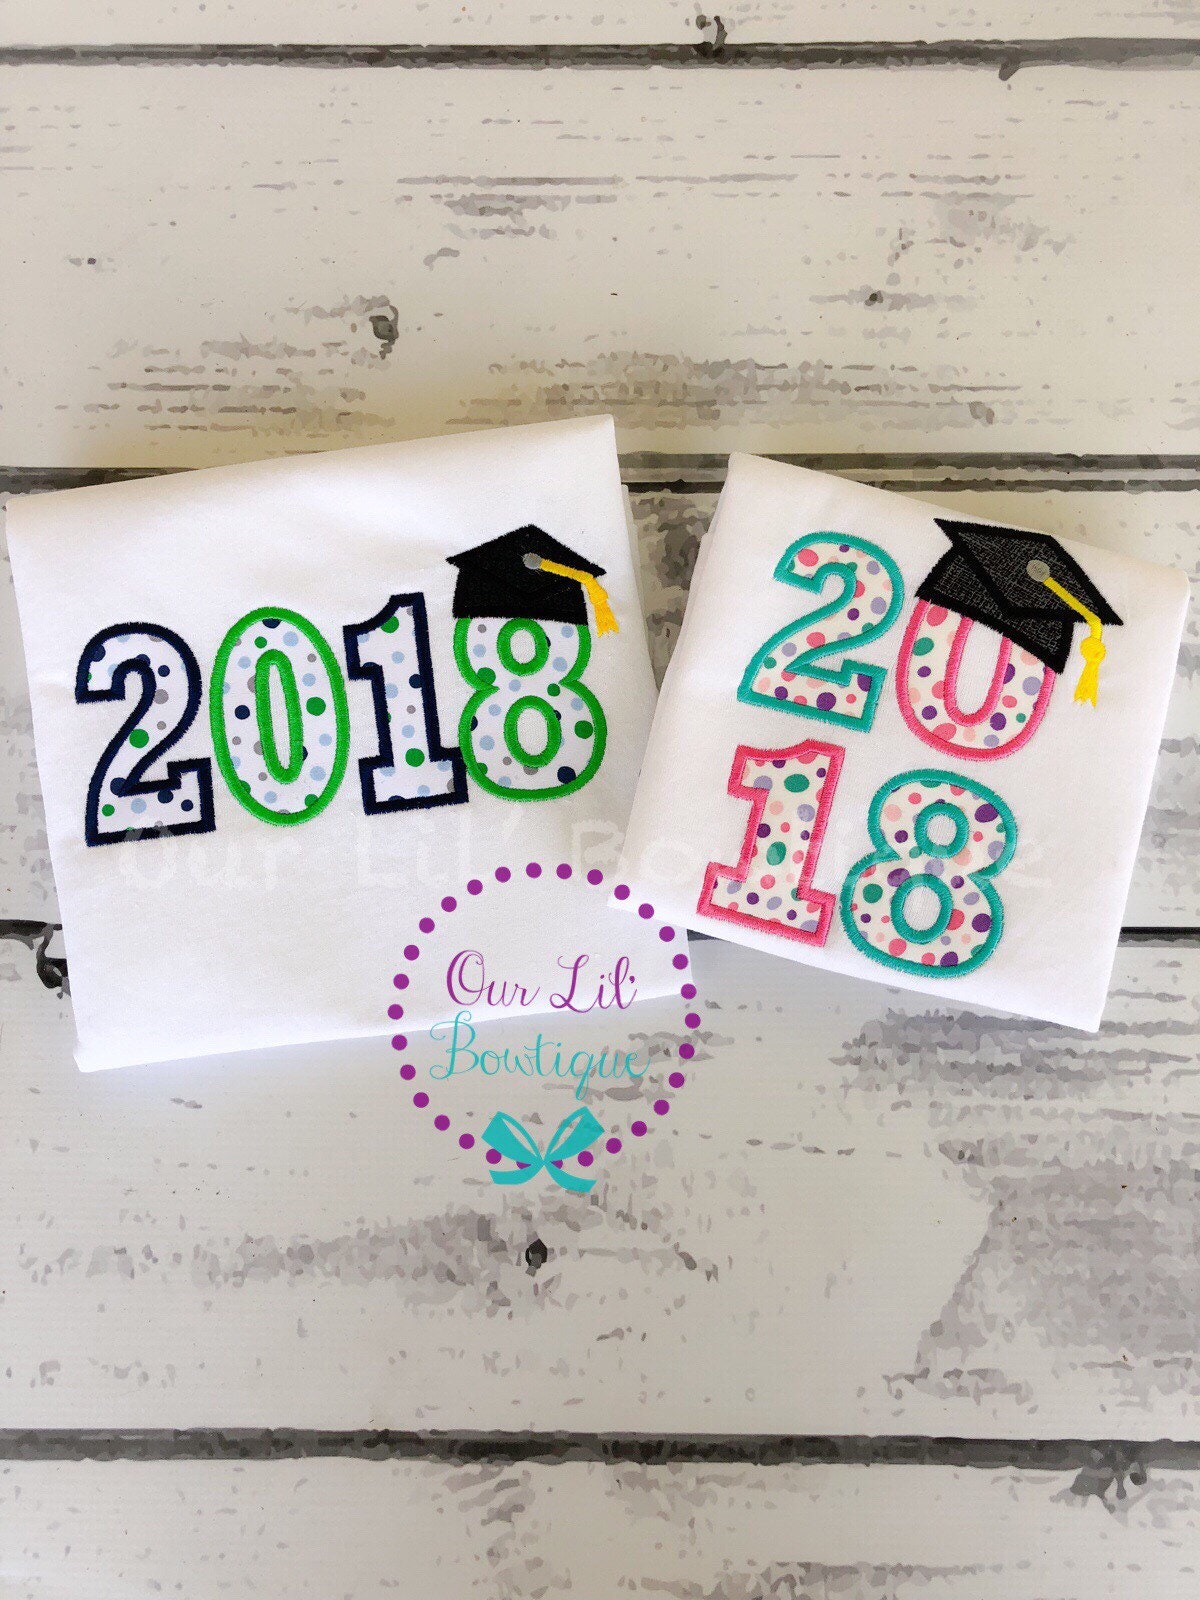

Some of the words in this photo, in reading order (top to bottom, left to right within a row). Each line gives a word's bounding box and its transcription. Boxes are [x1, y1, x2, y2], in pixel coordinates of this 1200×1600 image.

[75, 592, 607, 847] 2018
[737, 531, 1055, 762] 20
[697, 738, 1018, 978] 18
